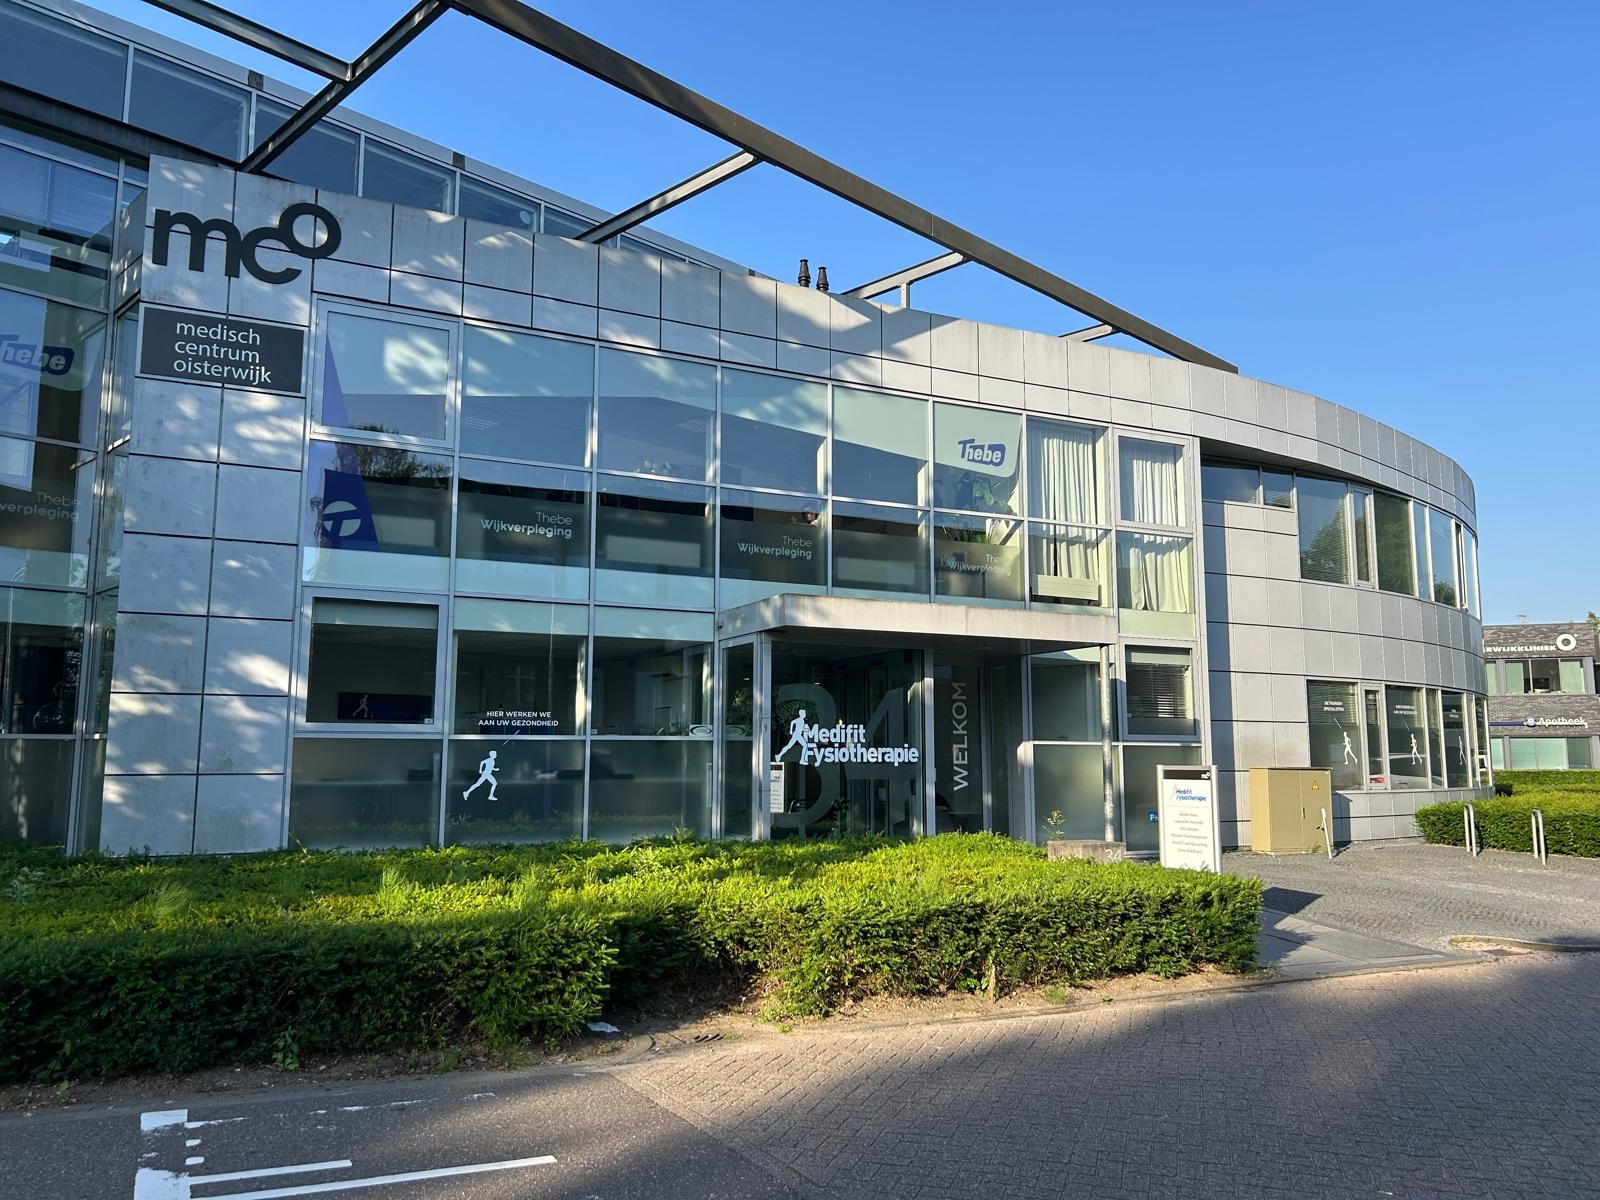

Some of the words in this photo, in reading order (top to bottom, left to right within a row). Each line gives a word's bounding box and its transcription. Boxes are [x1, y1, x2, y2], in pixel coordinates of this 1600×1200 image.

[152, 203, 341, 284] mco
[176, 322, 261, 346] medisch
[174, 341, 260, 364] centrum
[173, 357, 272, 385] oisterwijk
[958, 438, 1004, 465] Thebe
[480, 518, 573, 539] Wijkverpleging
[536, 511, 573, 526] Thebe
[738, 542, 812, 560] Wijkverpleging
[782, 535, 812, 548] Thebe
[511, 719, 559, 727] GEZONDHEID
[1538, 716, 1586, 728] Apotheek
[804, 723, 866, 743] Medifit
[952, 682, 968, 791] WELKOM
[805, 743, 919, 767] Fysiotherapie
[1105, 848, 1122, 862] 34
